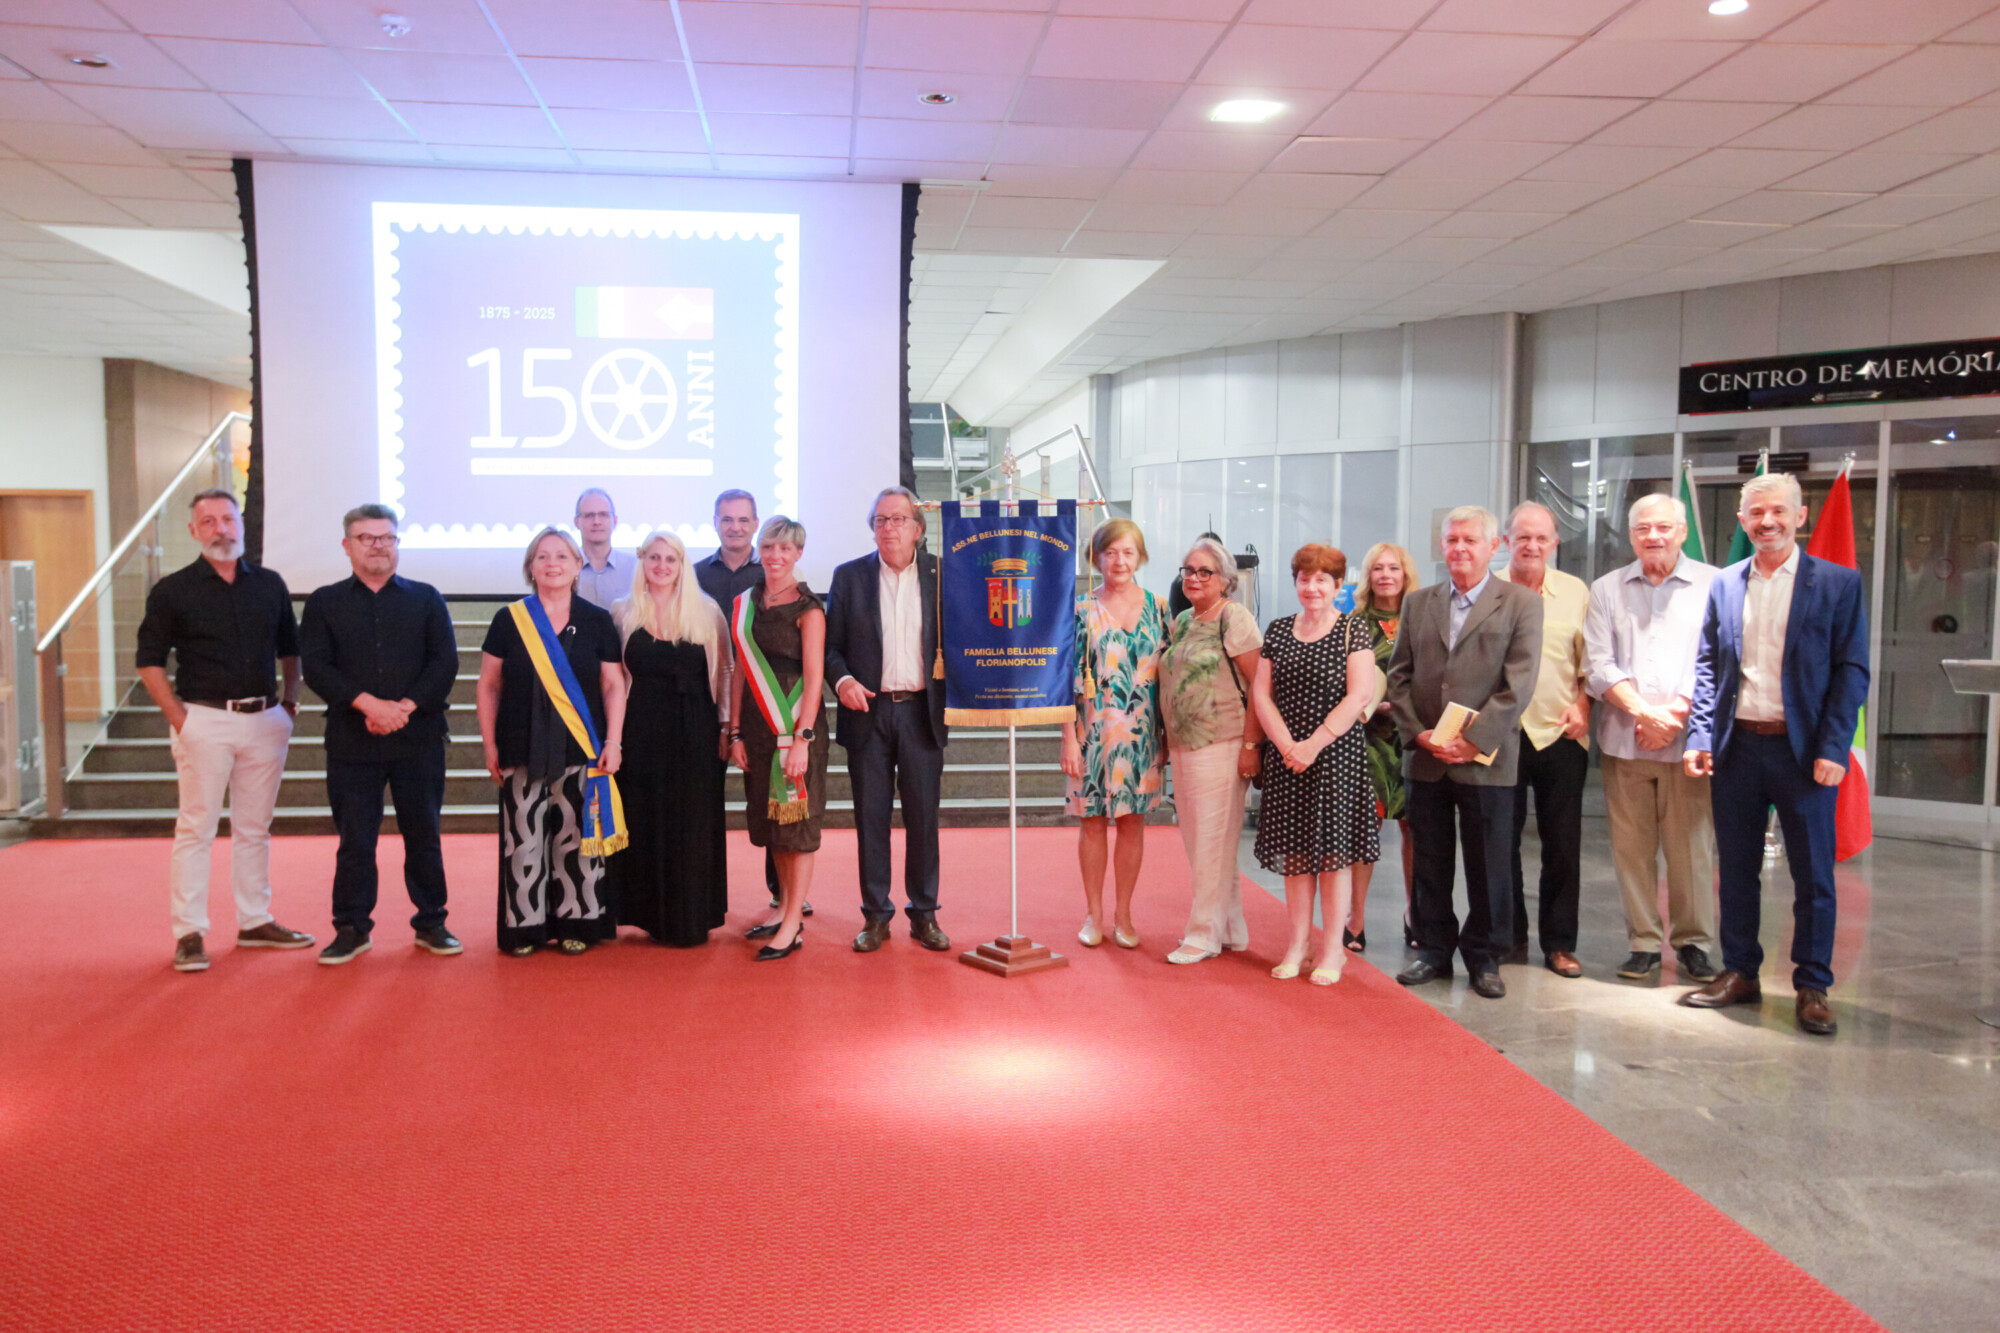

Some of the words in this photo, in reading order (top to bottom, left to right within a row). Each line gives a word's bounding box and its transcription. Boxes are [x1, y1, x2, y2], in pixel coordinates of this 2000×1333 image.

[480, 306, 510, 319] 1875
[524, 307, 556, 320] 2025
[1700, 368, 1807, 393] CENTRO
[1818, 364, 1853, 384] DE
[1863, 350, 2000, 380] MEMÓRI
[467, 347, 678, 451] 150
[687, 350, 715, 450] ANNI
[952, 534, 979, 553] ASS.NE
[979, 529, 1022, 540] BELLUNESI
[1024, 529, 1039, 539] NEL
[1040, 533, 1070, 551] MONDO
[964, 648, 1005, 656] FAMIGLIA
[1007, 647, 1058, 656] BELLUNESE
[976, 658, 1047, 667] FLORIANOPOLIS
